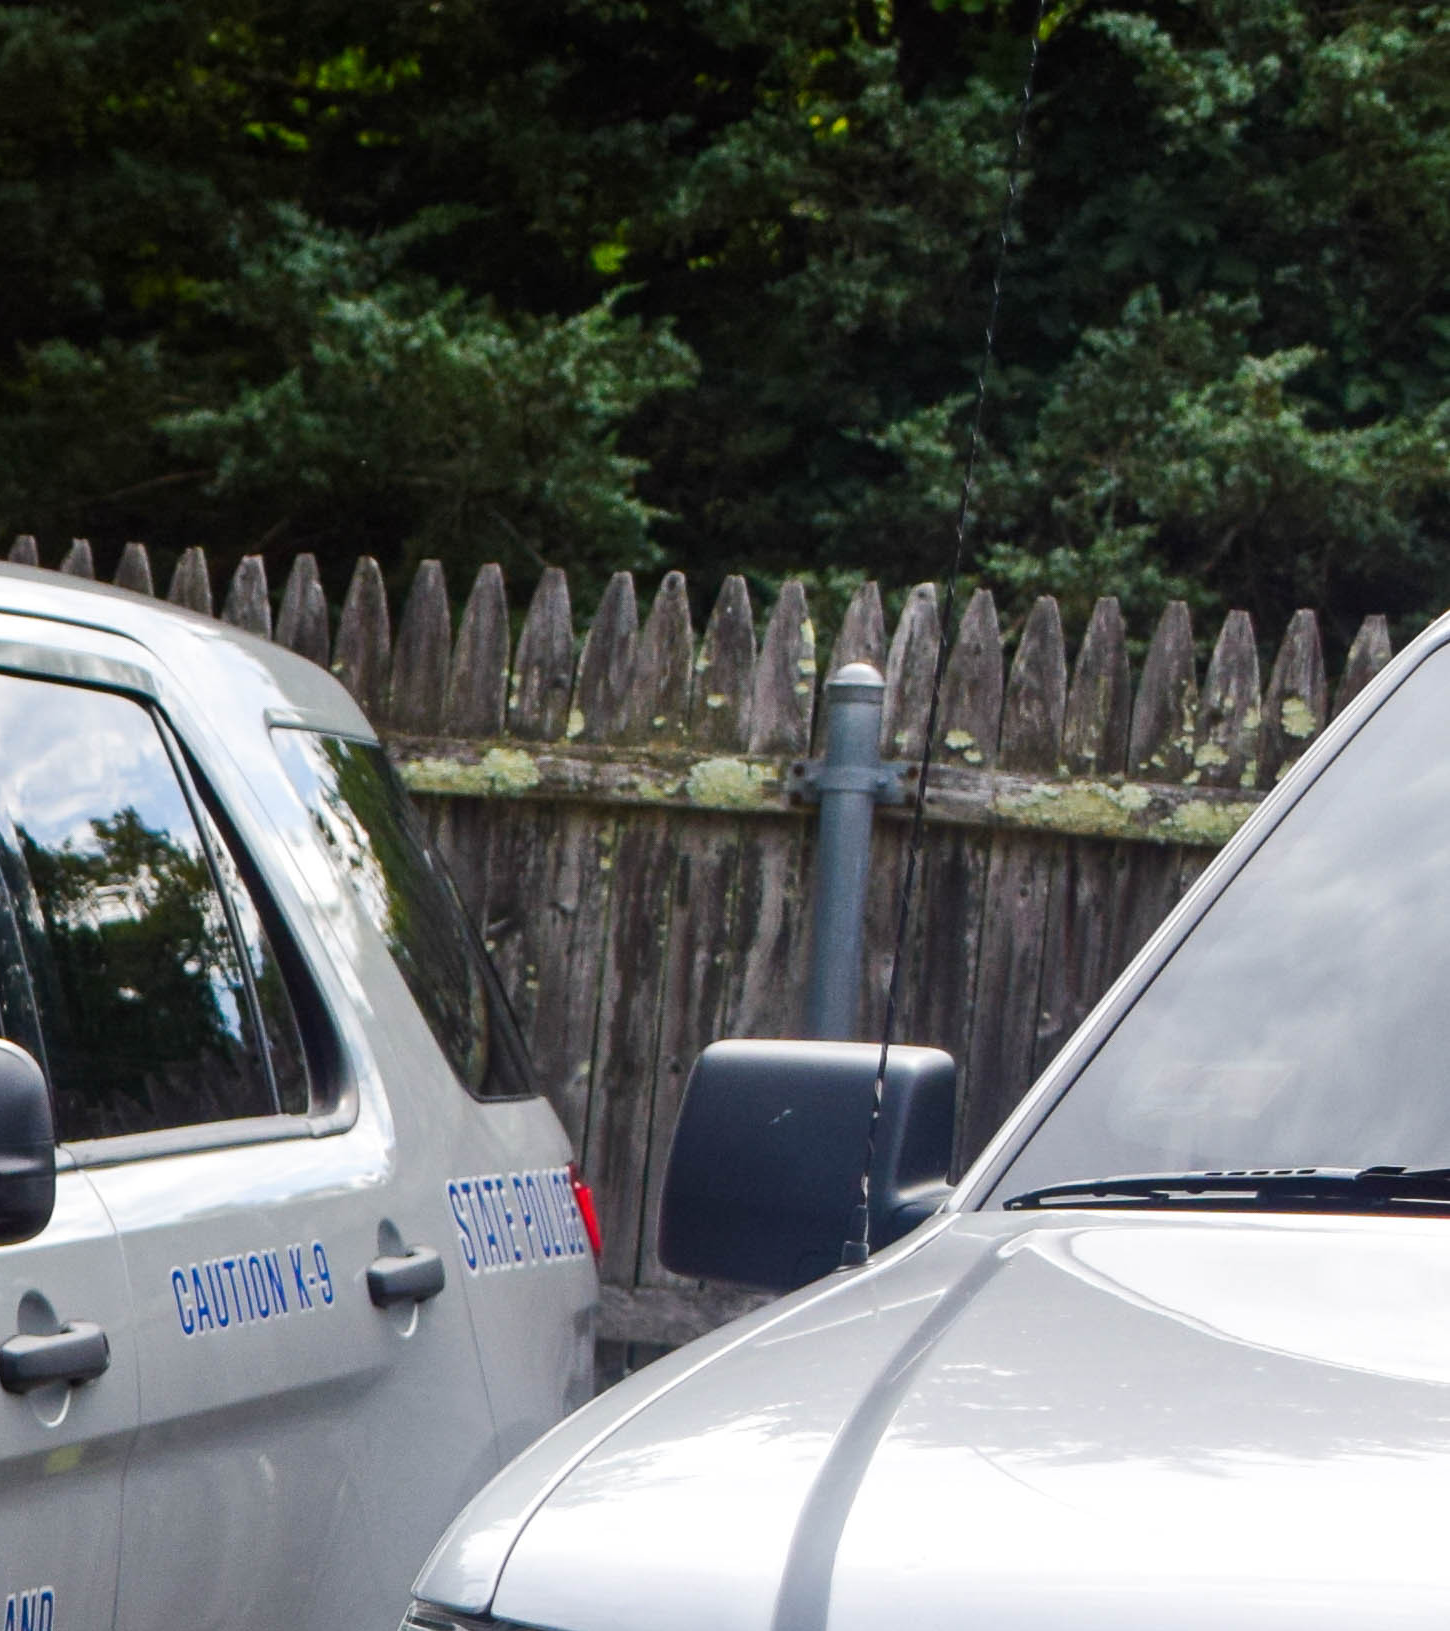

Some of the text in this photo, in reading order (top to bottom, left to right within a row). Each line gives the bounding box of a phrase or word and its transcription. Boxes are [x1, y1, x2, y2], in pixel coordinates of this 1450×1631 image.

[446, 1166, 586, 1276] STATE POLICE
[170, 1239, 335, 1338] CAUTION K-9
